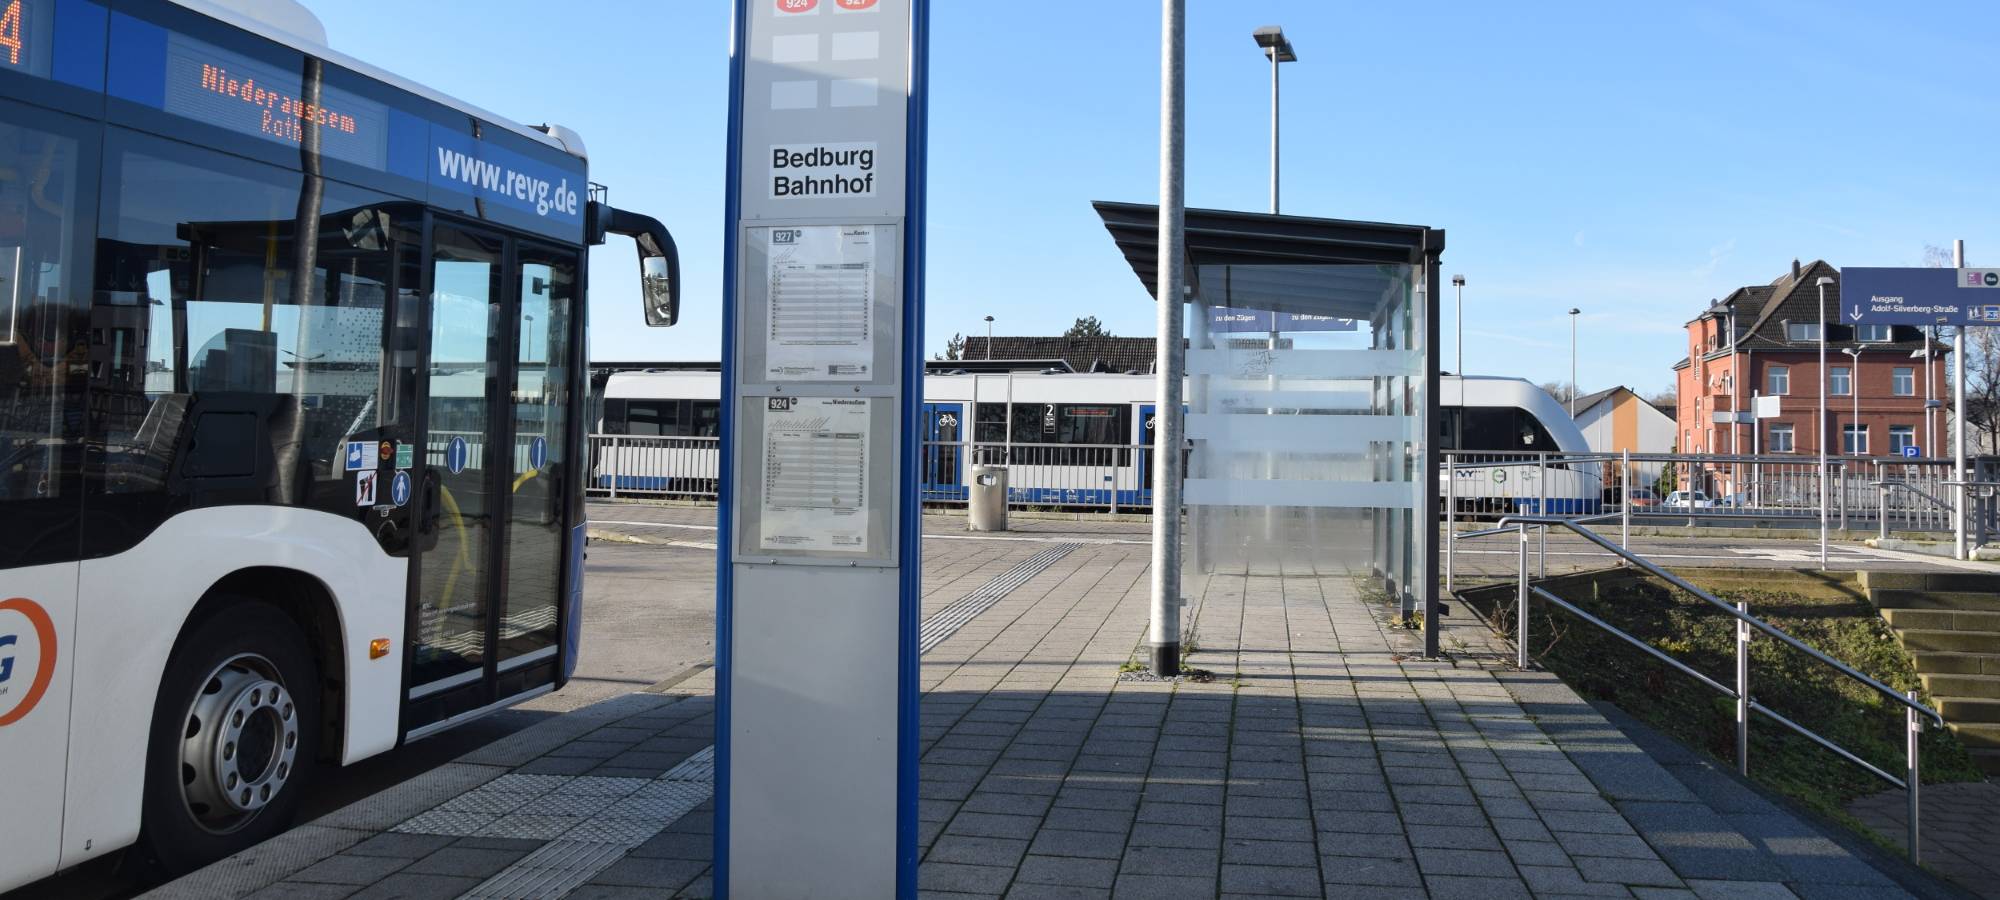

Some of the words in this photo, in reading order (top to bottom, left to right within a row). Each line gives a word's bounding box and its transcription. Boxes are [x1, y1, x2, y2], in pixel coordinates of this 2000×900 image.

[0, 0, 21, 64] 4
[202, 63, 356, 134] Niederaussem
[773, 146, 874, 170] Bedburg
[438, 147, 577, 216] www.revg.de
[773, 172, 873, 197] Bahnhof
[775, 231, 791, 242] 927
[1871, 295, 1904, 304] Ausgang
[1871, 304, 1959, 314] Adolf-Silverberg-Straße
[1236, 314, 1256, 322] Zügen
[1300, 313, 1312, 321] den
[771, 398, 787, 409] 924
[1046, 404, 1054, 416] 2
[1907, 448, 1916, 457] P
